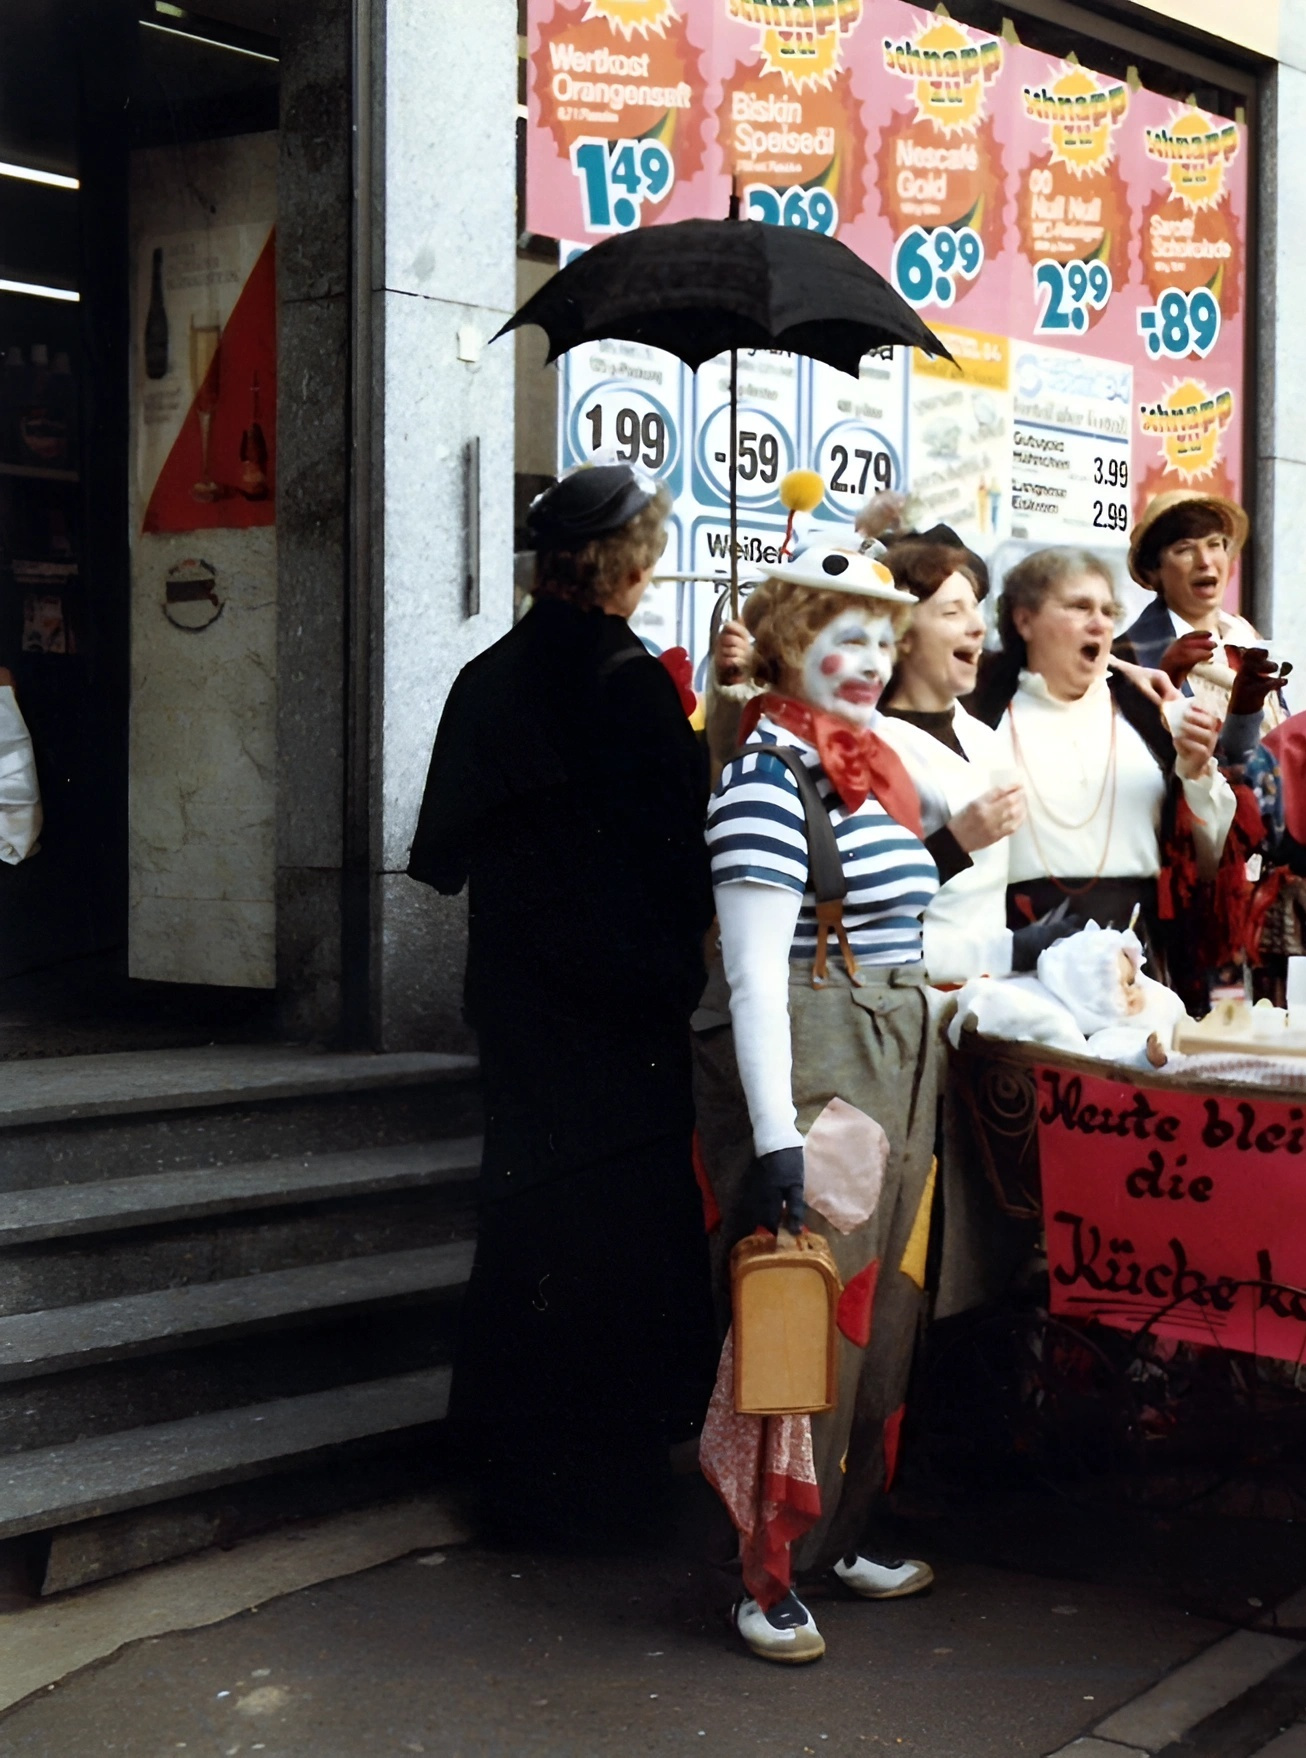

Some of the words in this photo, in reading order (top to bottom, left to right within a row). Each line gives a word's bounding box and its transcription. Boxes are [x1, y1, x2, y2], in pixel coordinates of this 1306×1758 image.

[549, 41, 650, 77] Wertkost
[552, 72, 692, 110] Orangensaft
[731, 90, 802, 124] Biskin
[734, 122, 835, 160] Speiseöl
[896, 170, 947, 200] Gold
[1093, 457, 1129, 488] 3.99
[1092, 500, 1128, 532] 2.99
[1039, 1069, 1181, 1142] Heute
[1126, 1149, 1214, 1202] die
